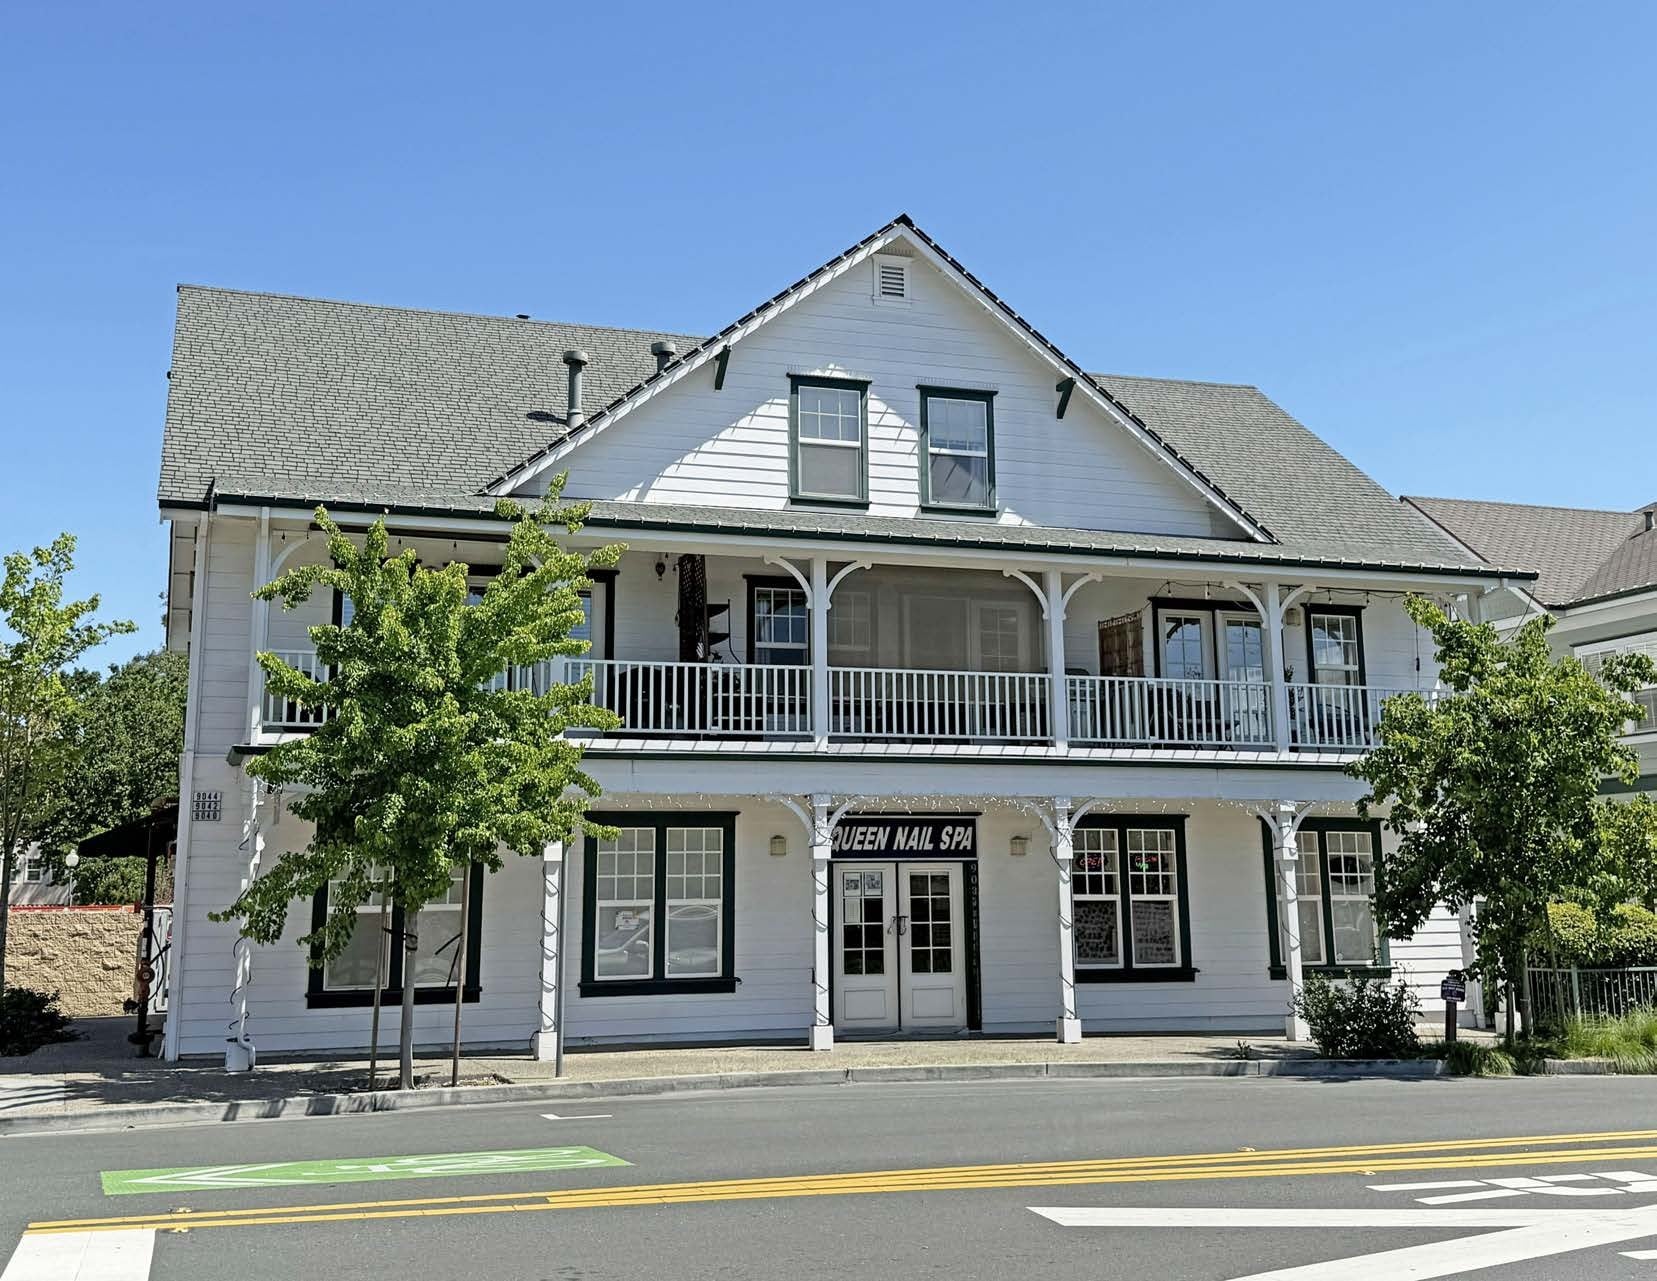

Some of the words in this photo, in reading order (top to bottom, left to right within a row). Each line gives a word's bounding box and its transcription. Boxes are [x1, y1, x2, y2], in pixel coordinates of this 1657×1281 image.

[196, 792, 218, 801] 9044
[195, 802, 218, 810] 9042
[195, 812, 217, 820] 9040
[831, 825, 891, 852] QUEEN
[893, 826, 934, 851] NAIL
[939, 825, 973, 851] SPA
